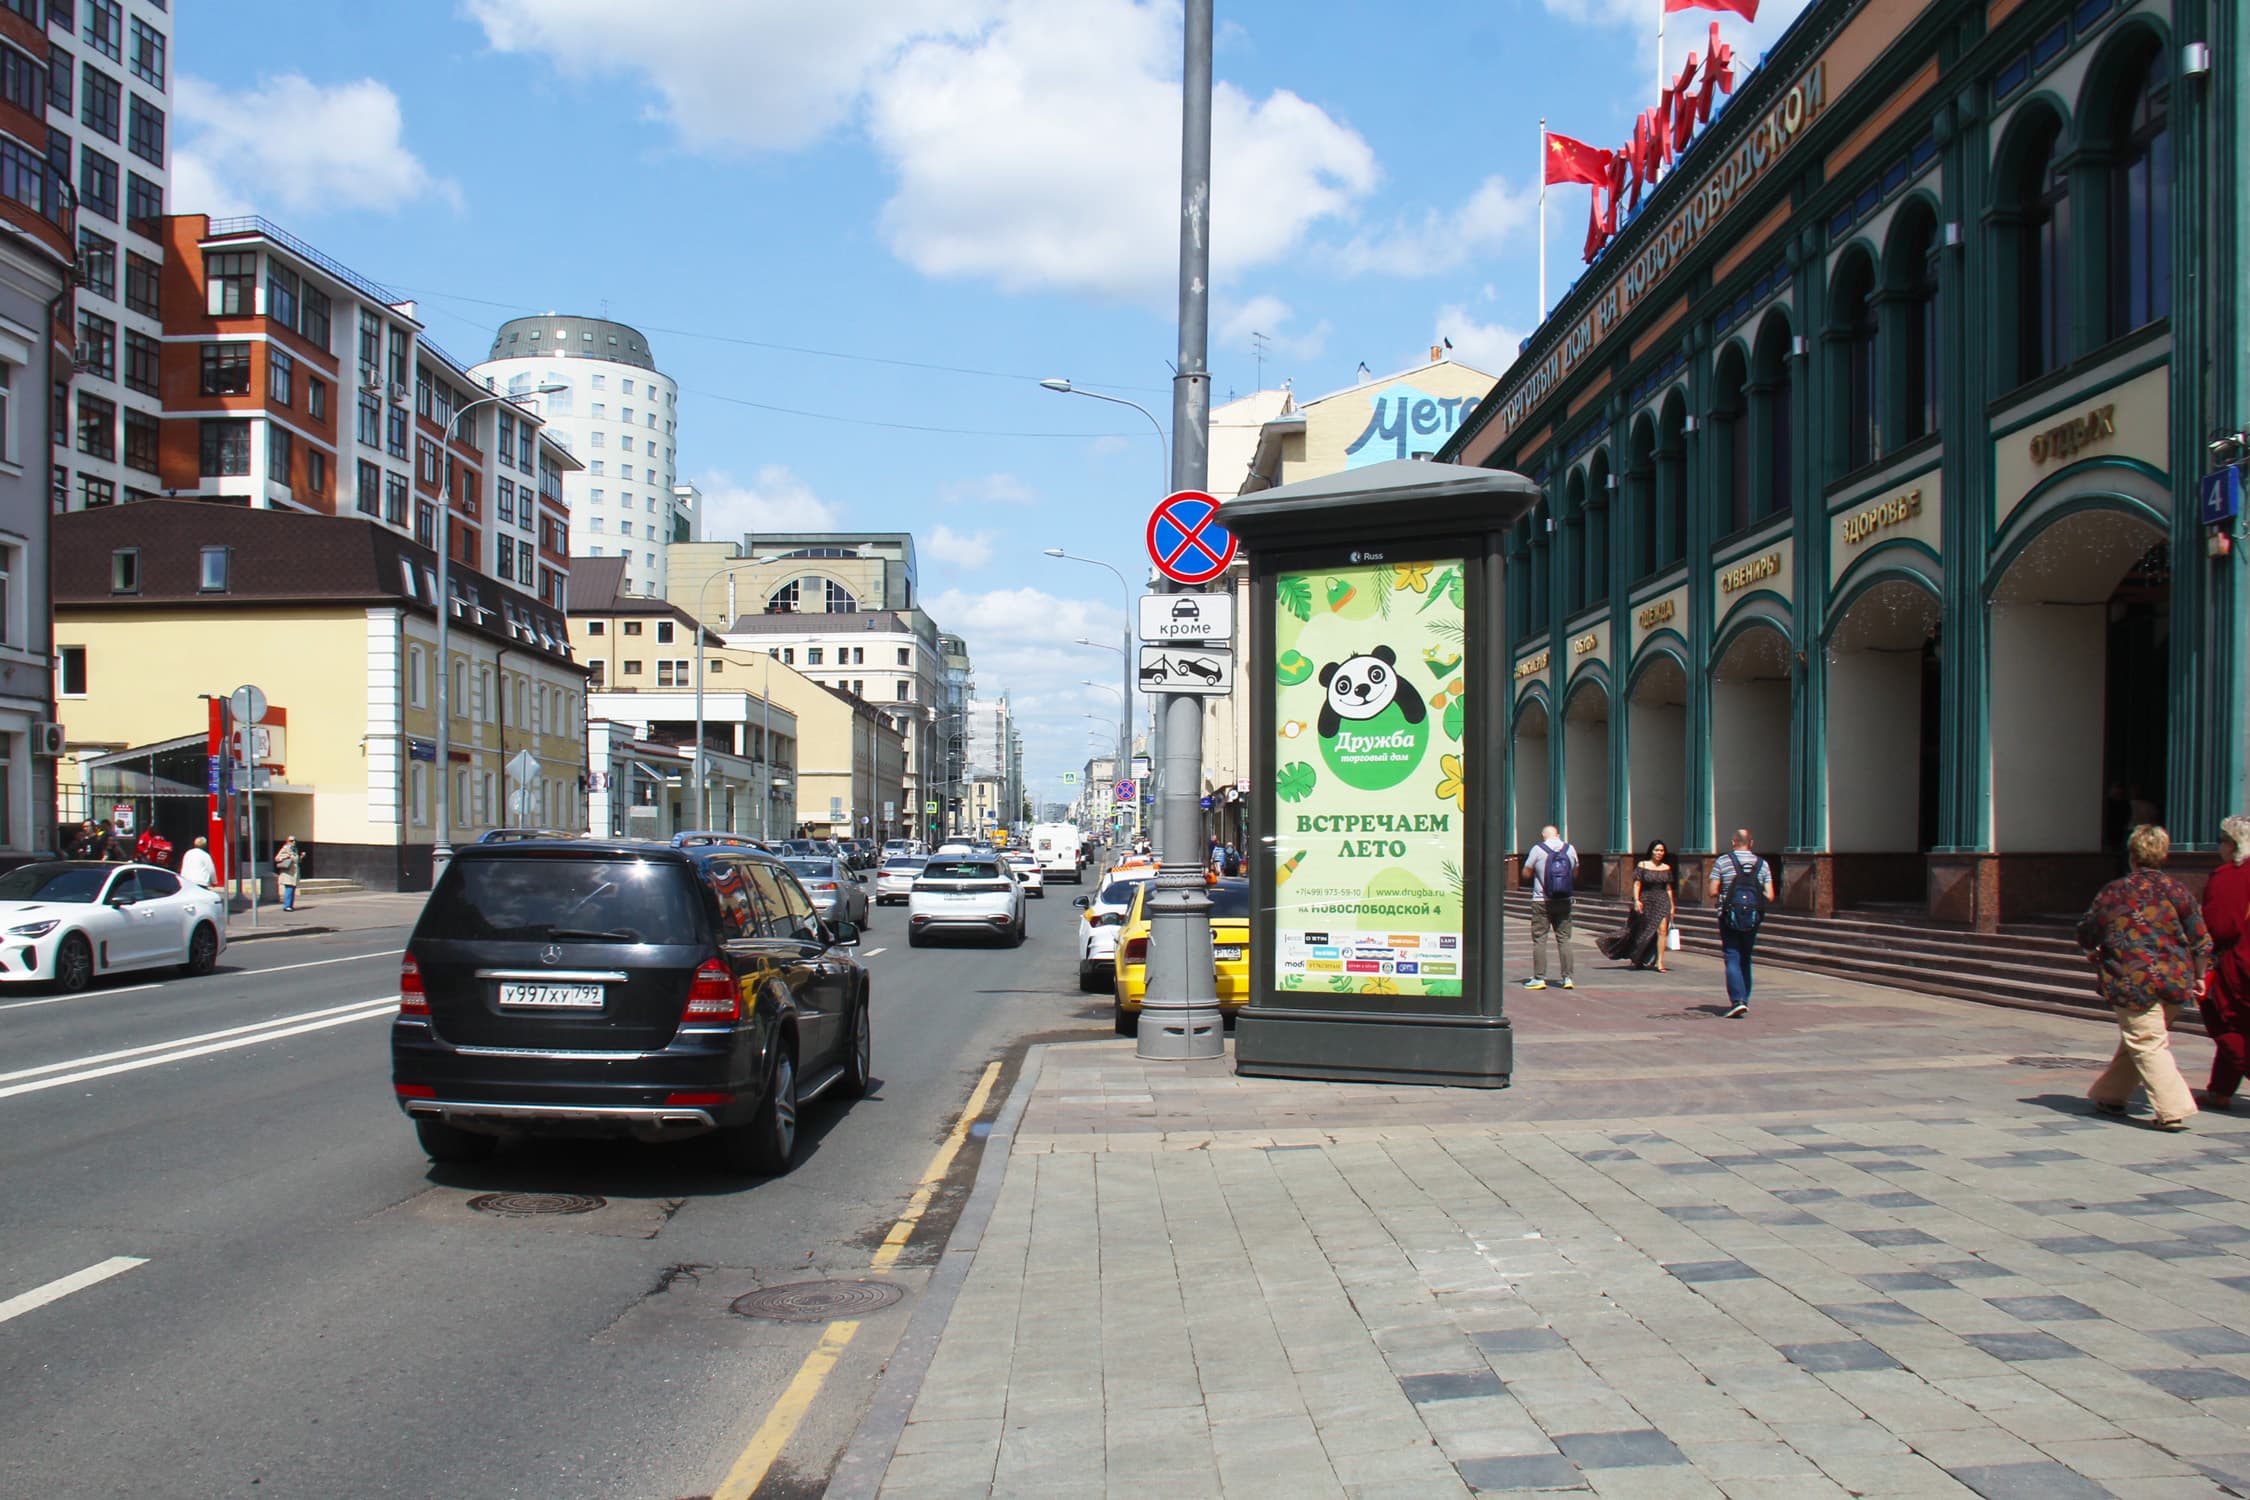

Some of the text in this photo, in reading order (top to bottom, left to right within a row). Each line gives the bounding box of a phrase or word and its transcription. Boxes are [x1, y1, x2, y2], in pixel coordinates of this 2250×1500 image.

[1564, 314, 1592, 369] ДОМ
[1599, 287, 1619, 330] НА
[2208, 479, 2222, 511] 4
[1843, 488, 1921, 544] ЗДОРОВЬЕ
[1721, 552, 1780, 594] СУВЕНИРЫ
[1160, 624, 1211, 637] кроме
[1334, 730, 1415, 752] Дружба
[1341, 752, 1409, 763] торговый дом
[1296, 814, 1450, 832] ВСТРЕЧАЕМ
[1338, 839, 1407, 858] ЛЕТО
[1376, 887, 1445, 898] www.drugba.ru
[1312, 902, 1430, 916] НОВОСЛОБОДСКОЙ
[1433, 905, 1441, 915] 4
[506, 985, 599, 1002] У997ХУ 799
